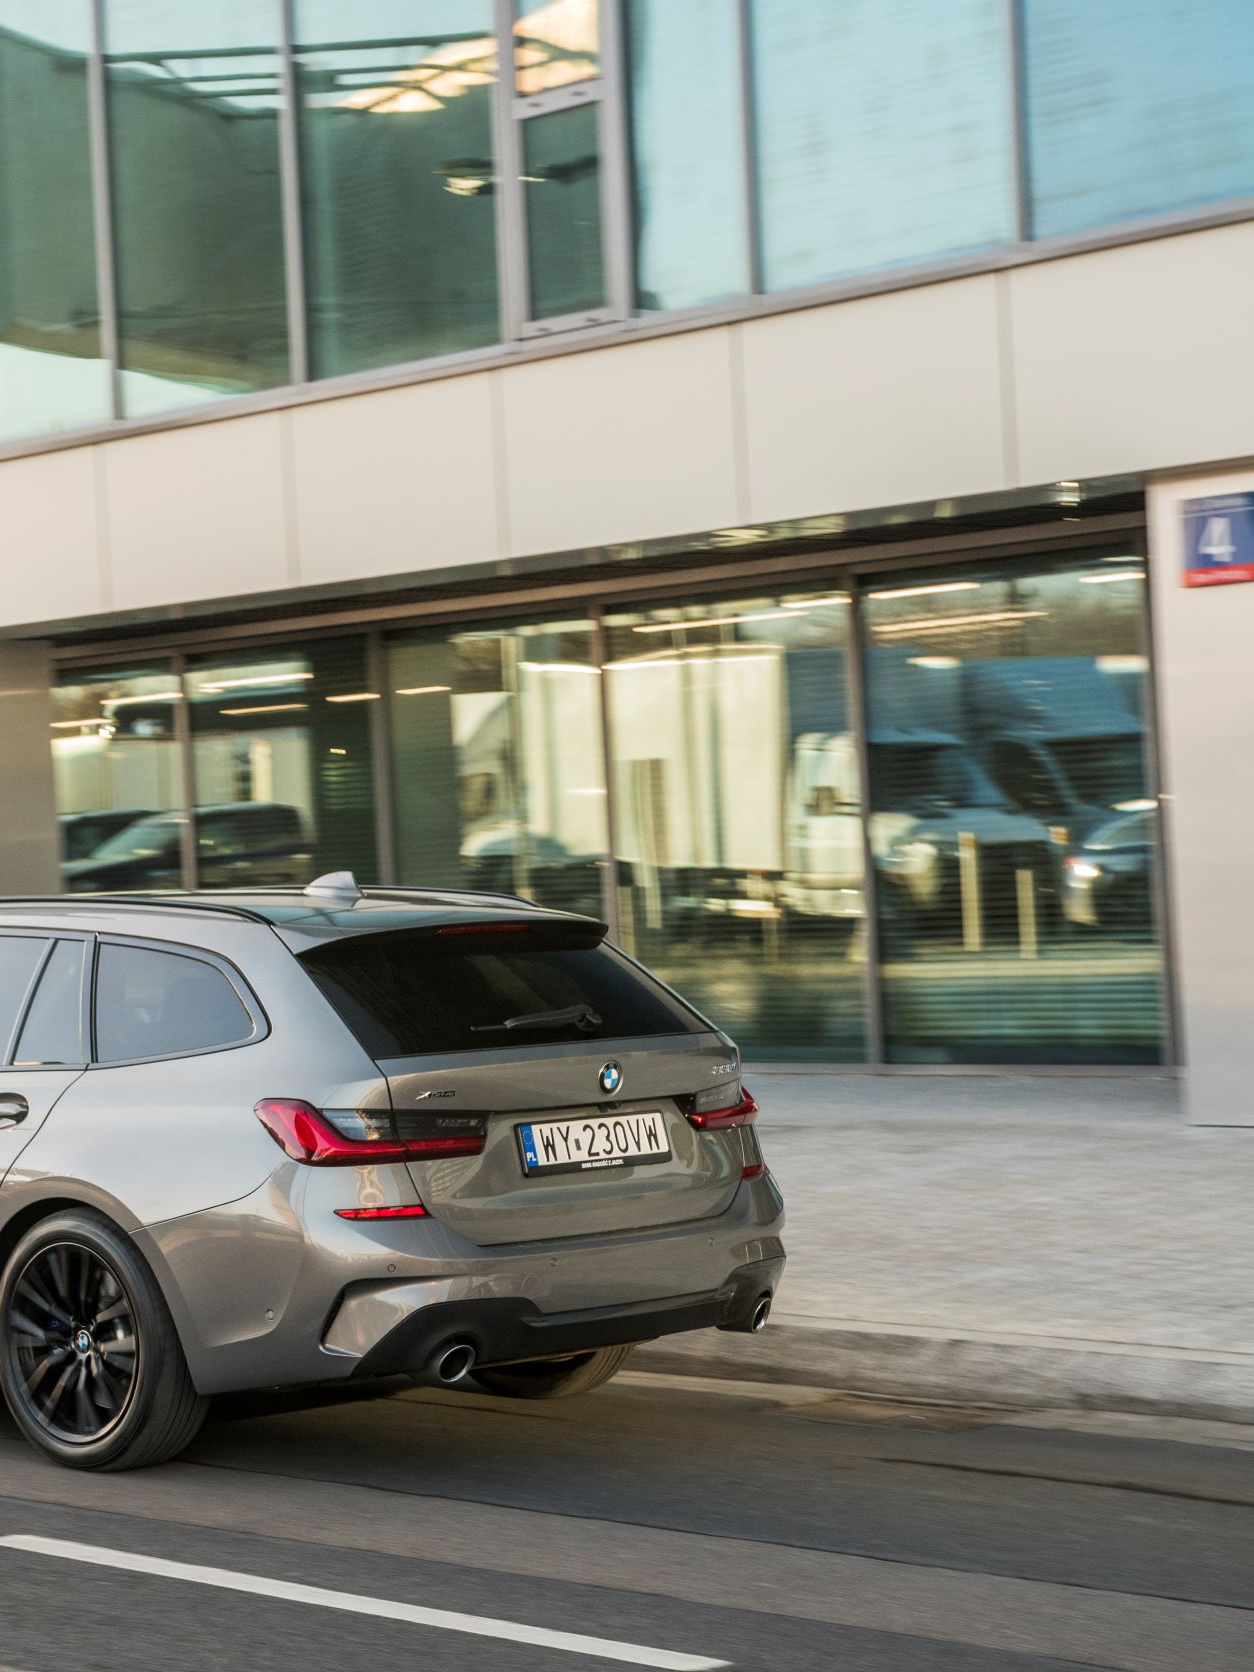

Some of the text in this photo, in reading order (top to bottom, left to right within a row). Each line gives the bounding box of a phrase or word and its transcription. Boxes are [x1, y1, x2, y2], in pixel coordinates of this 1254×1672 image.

[1198, 517, 1237, 562] 4
[526, 1152, 537, 1162] PL
[540, 1117, 660, 1162] WY 230VW
